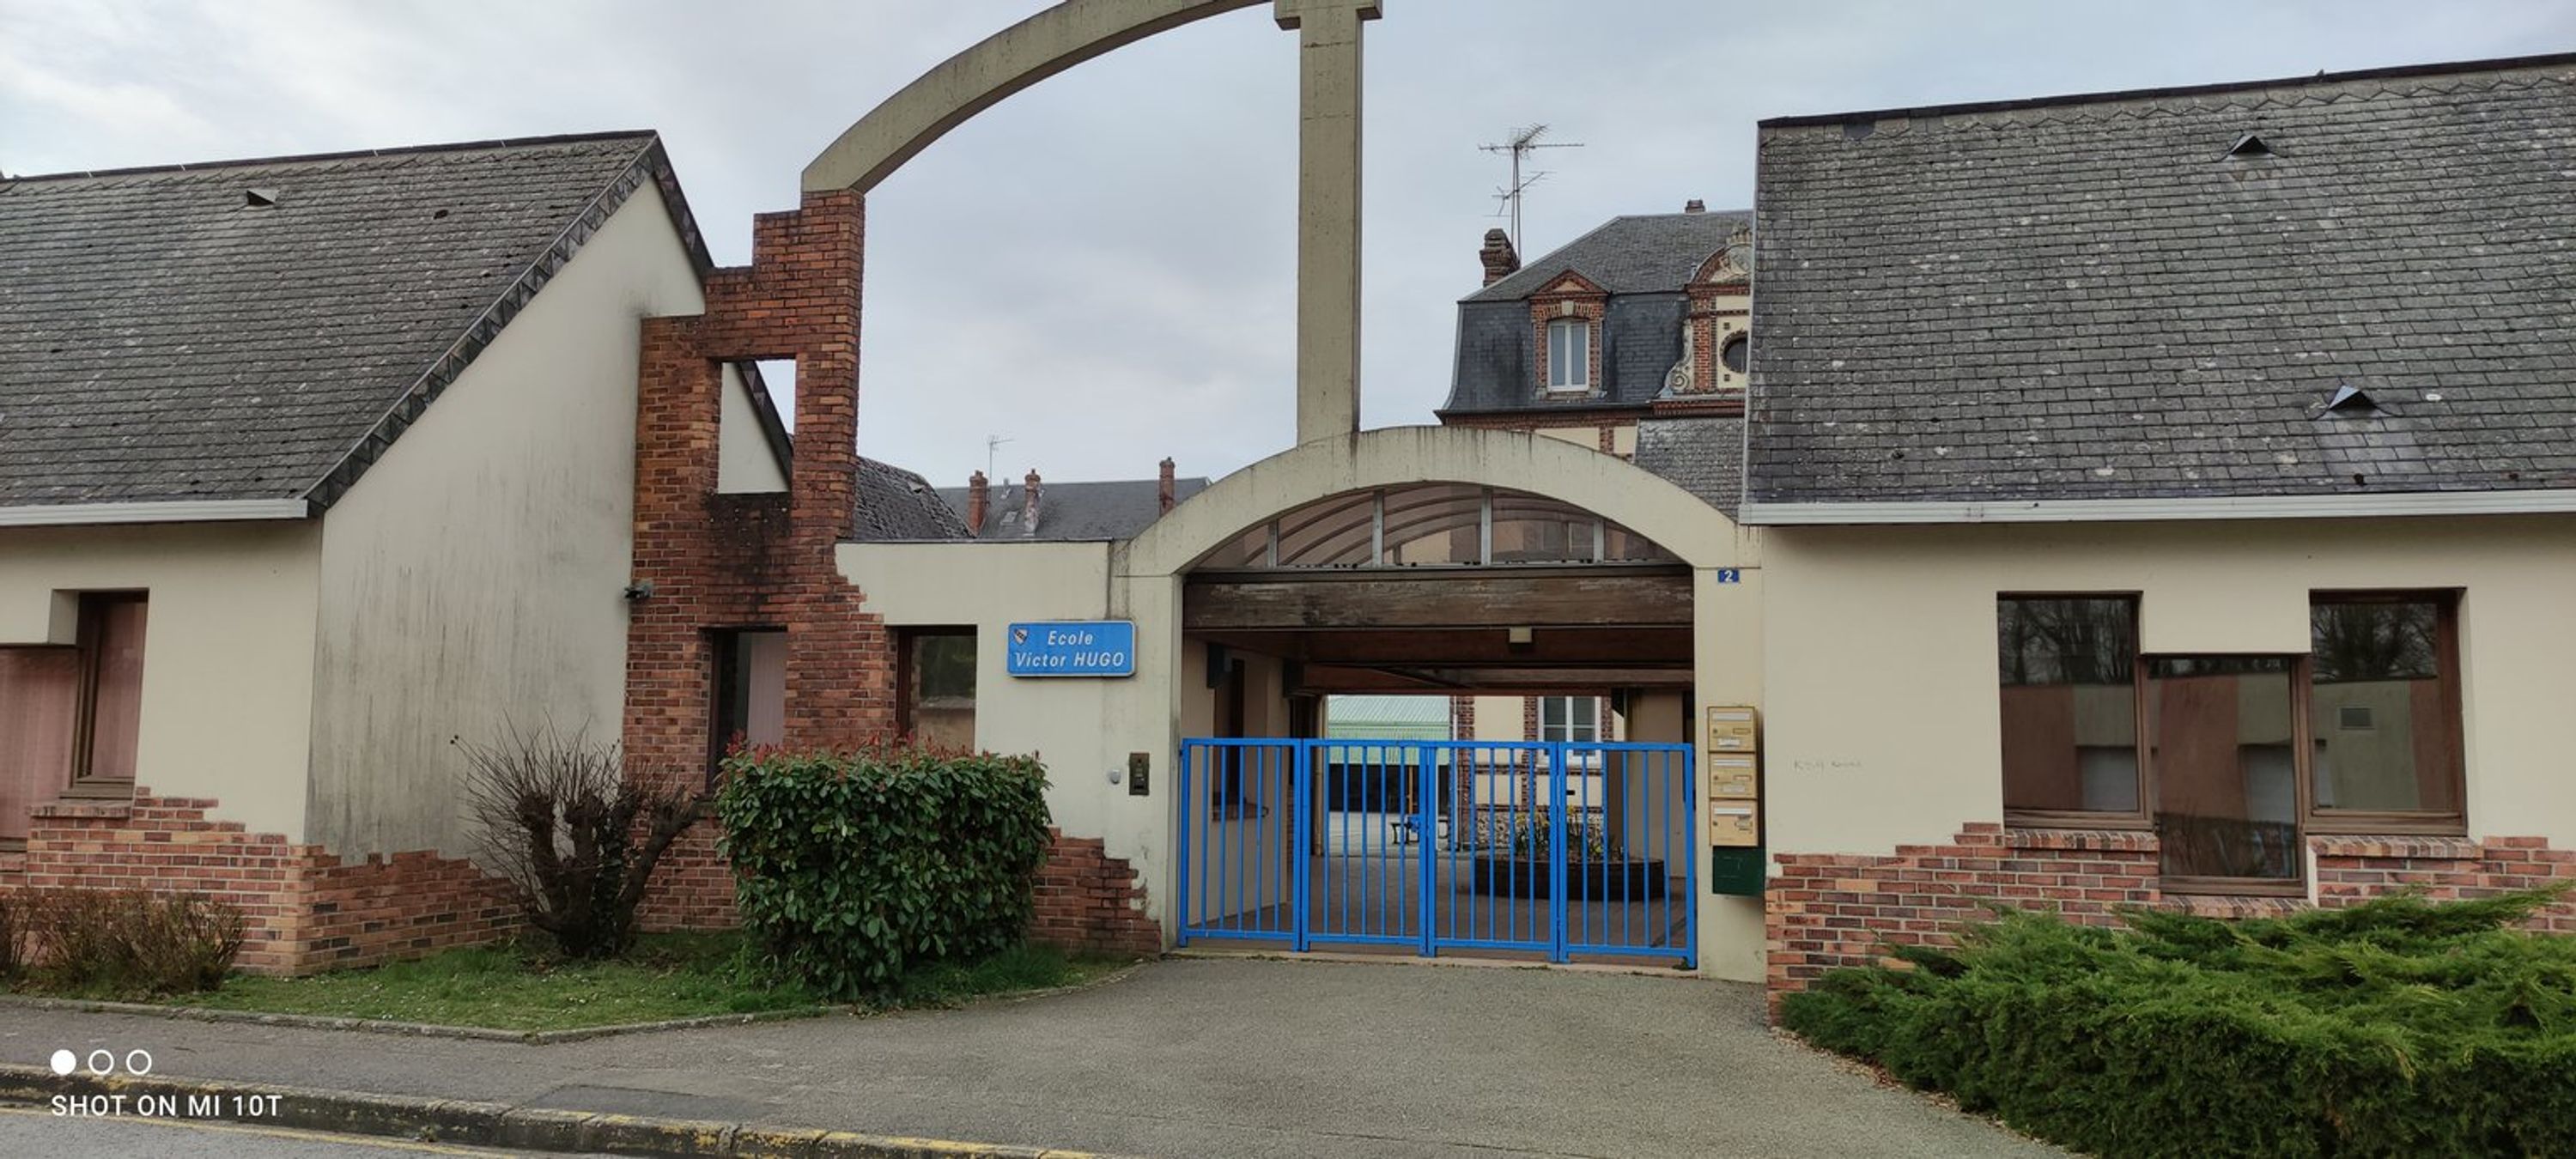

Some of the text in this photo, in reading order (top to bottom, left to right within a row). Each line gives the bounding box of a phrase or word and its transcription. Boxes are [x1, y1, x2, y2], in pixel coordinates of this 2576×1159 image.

[1724, 570, 1733, 581] 2
[1048, 630, 1093, 646] Ecole
[1015, 652, 1124, 667] Victor HUGO
